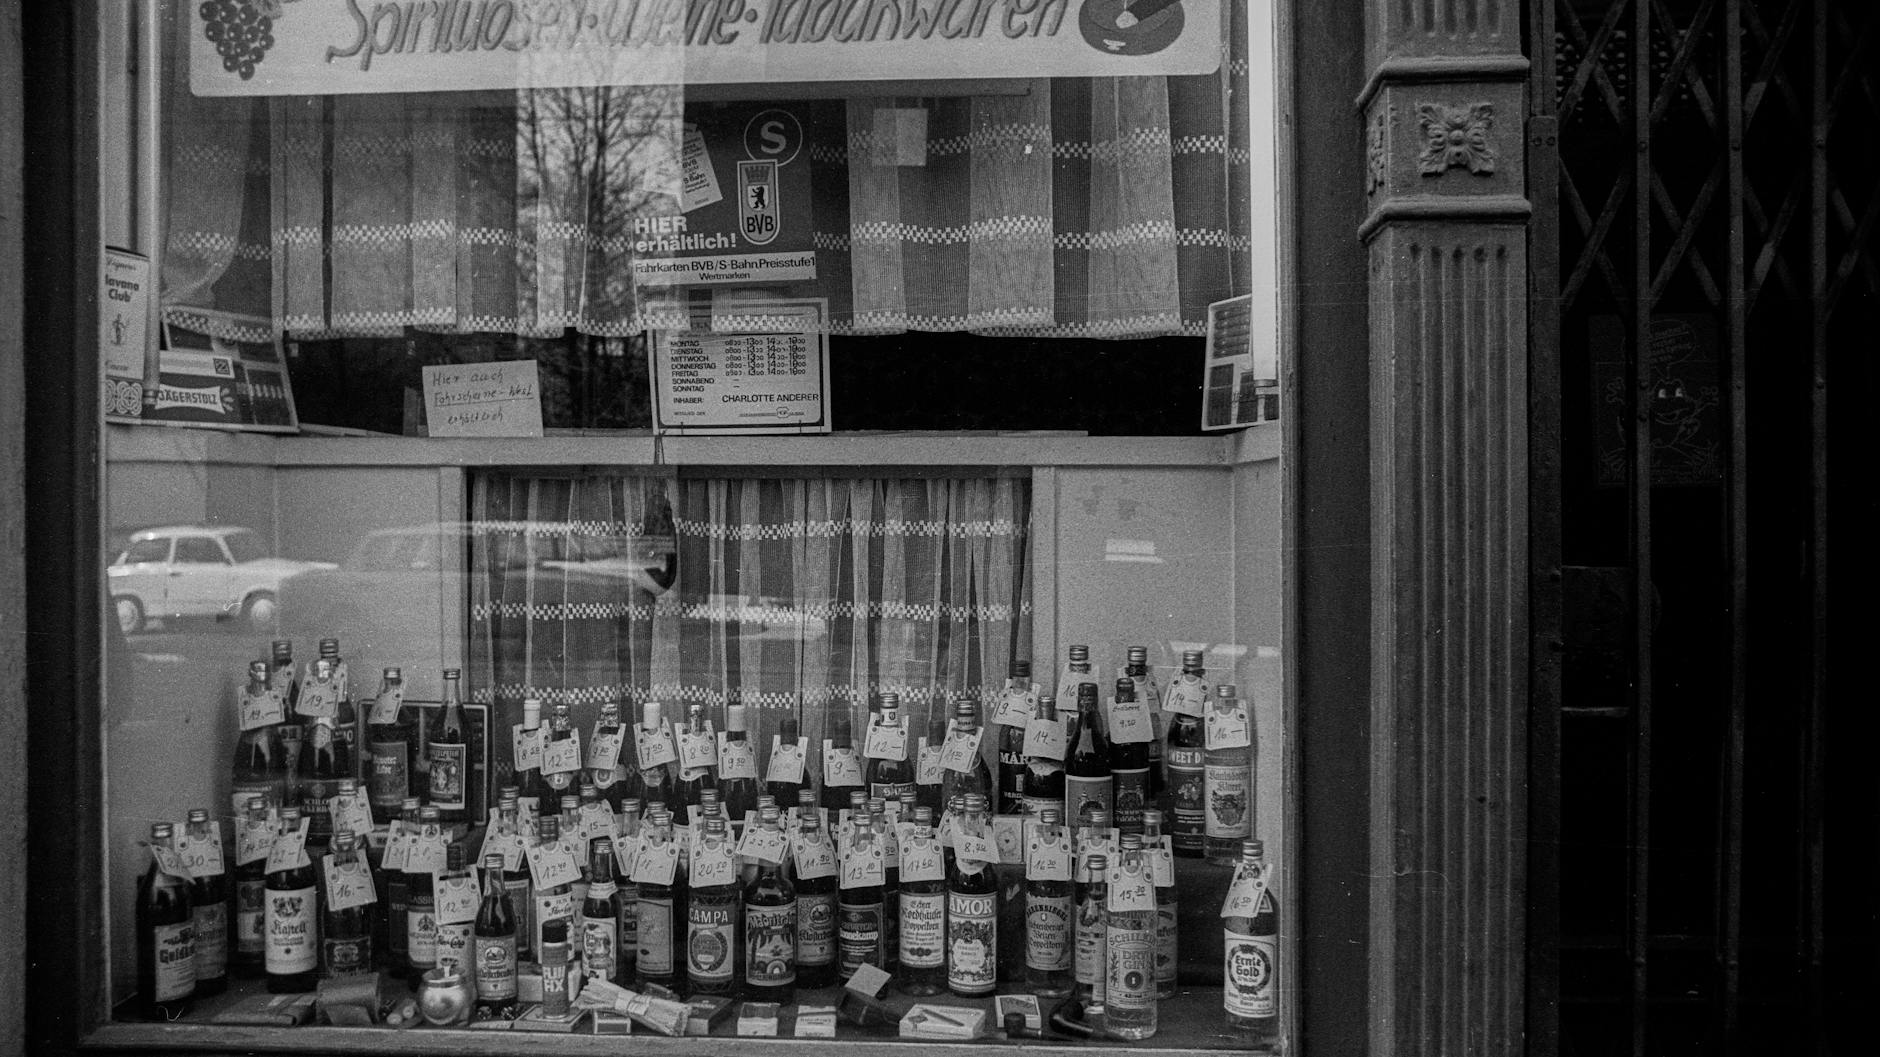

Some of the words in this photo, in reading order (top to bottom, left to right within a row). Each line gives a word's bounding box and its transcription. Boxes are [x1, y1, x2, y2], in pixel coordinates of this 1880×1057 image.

[760, 121, 787, 154] S
[634, 216, 688, 234] HIER
[747, 214, 774, 235] BVB
[636, 233, 737, 252] erhältlich!
[635, 260, 690, 273] Fahrkarten
[699, 272, 751, 281] Wertmarken
[108, 288, 132, 302] Club
[433, 372, 460, 387] Hier
[471, 368, 504, 384] auch
[672, 377, 715, 385] SONNABEND
[672, 385, 705, 393] SONNTAG
[722, 394, 775, 403] CHARLOTTE
[777, 393, 819, 402] ANDERER
